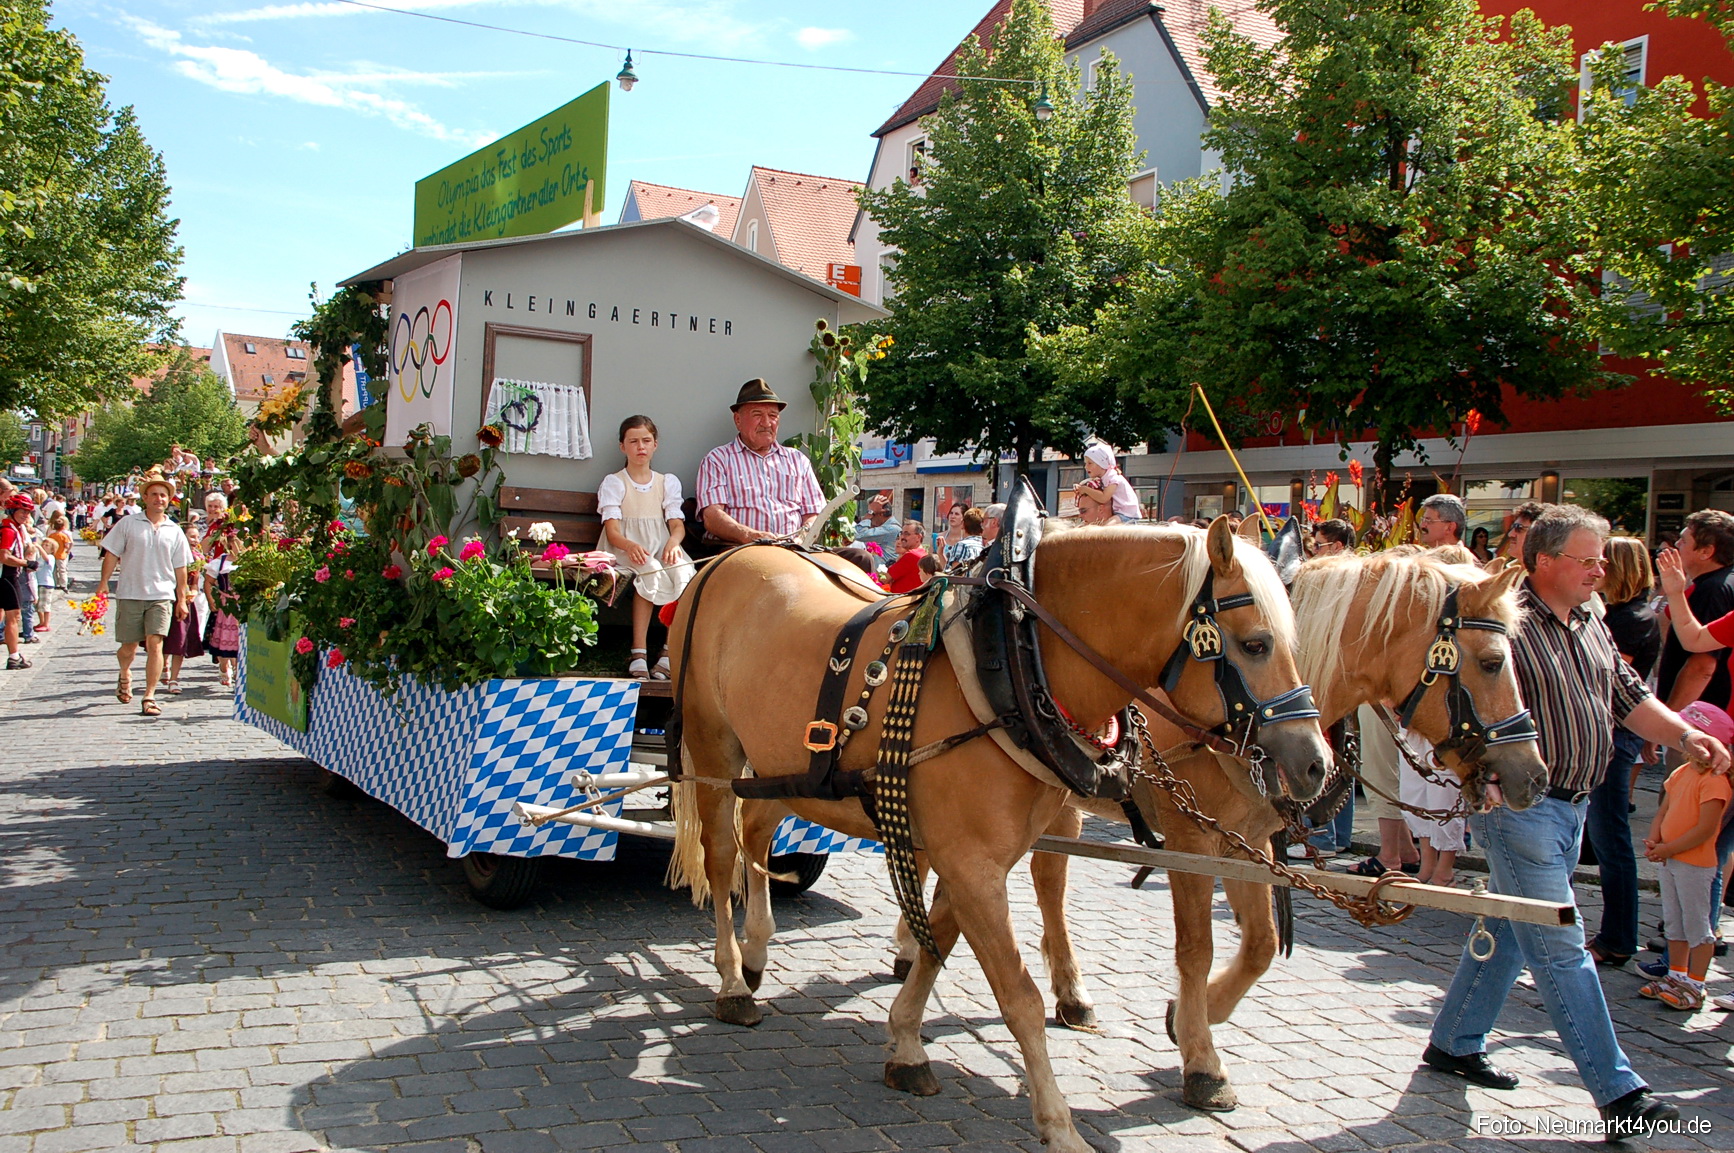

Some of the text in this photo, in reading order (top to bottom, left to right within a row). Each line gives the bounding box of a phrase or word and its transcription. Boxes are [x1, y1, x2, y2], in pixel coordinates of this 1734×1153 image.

[437, 123, 573, 215] Olympia das Fest des Sports
[459, 210, 472, 238] die
[473, 188, 538, 237] Kleingärtner
[538, 177, 559, 207] aller
[562, 161, 590, 198] Orts
[484, 290, 733, 336] KLEINGAERTNER
